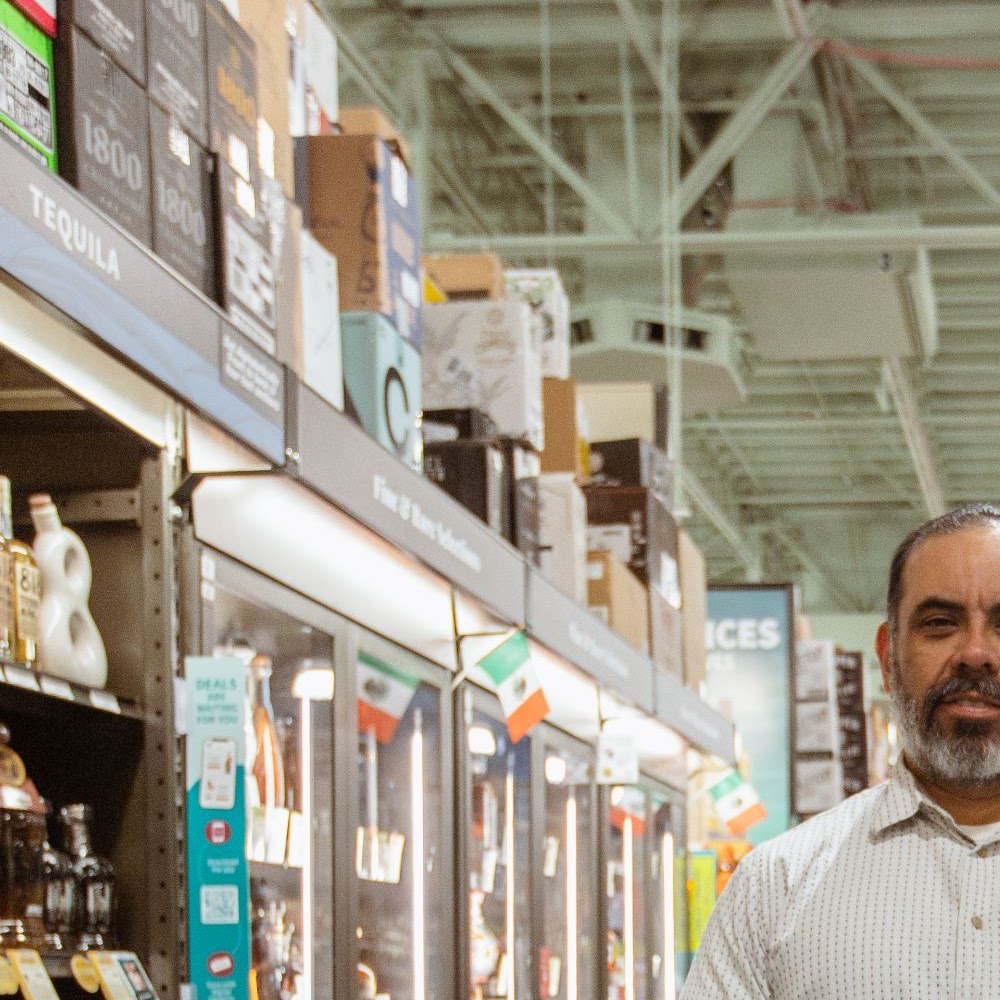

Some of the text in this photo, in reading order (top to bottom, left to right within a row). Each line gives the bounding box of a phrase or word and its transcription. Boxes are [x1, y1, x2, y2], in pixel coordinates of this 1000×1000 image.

[82, 112, 143, 191] 1800
[29, 183, 121, 282] TEQUILA
[156, 176, 207, 247] 1800
[706, 617, 781, 650] ICES
[196, 678, 237, 691] DEALS
